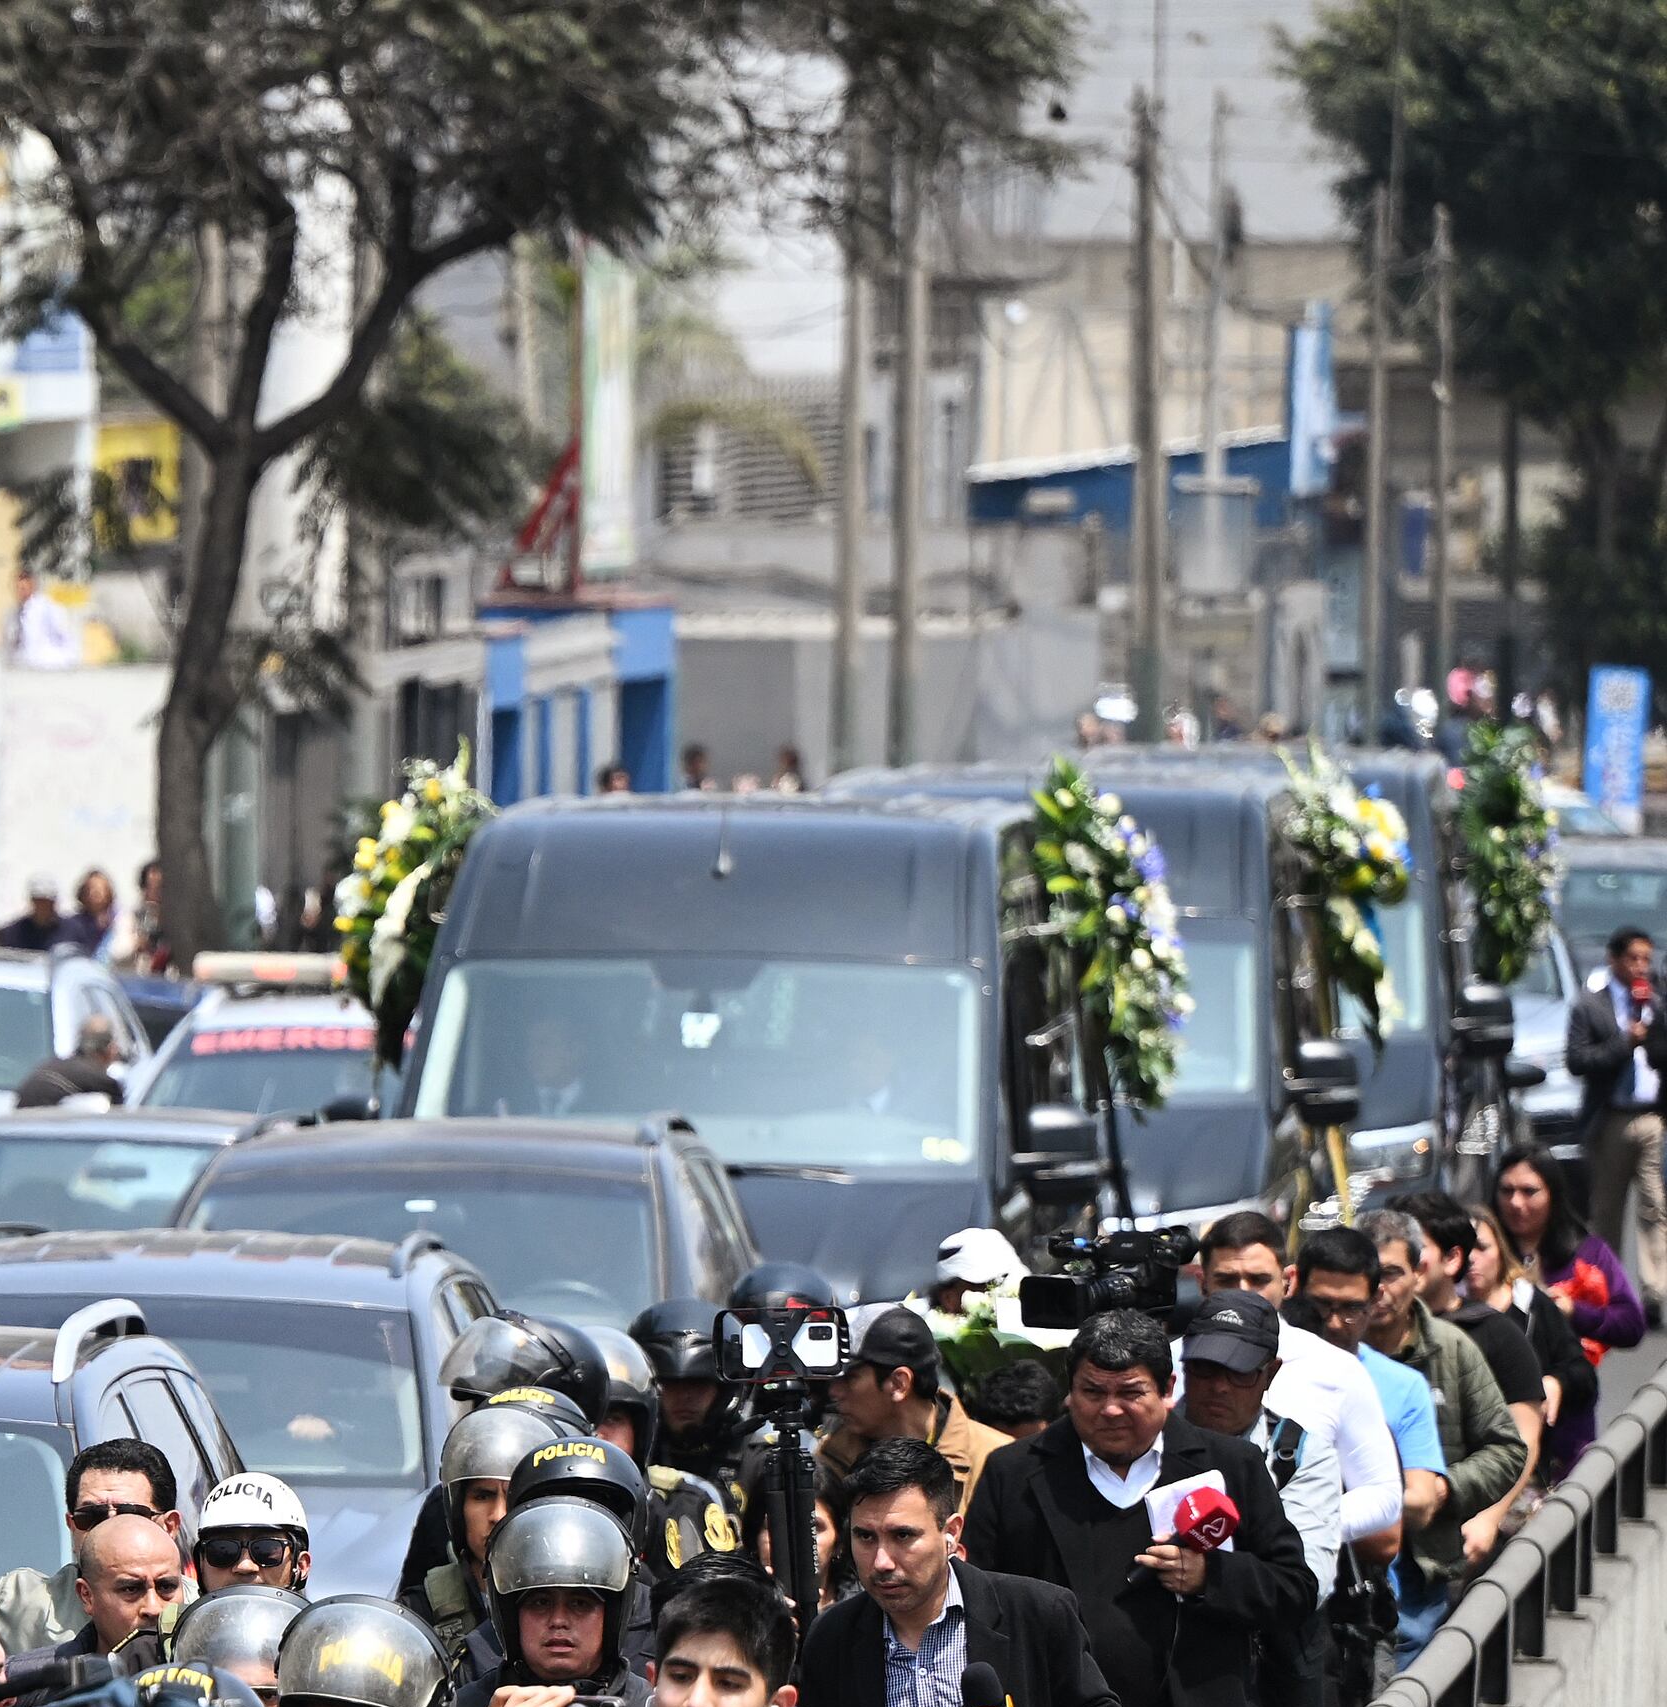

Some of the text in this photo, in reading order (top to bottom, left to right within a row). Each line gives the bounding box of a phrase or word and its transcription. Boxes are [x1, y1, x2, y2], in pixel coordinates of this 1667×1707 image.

[191, 1026, 380, 1056] EMERGE
[532, 1442, 607, 1468] POLICIA
[204, 1482, 273, 1512] POLICIA
